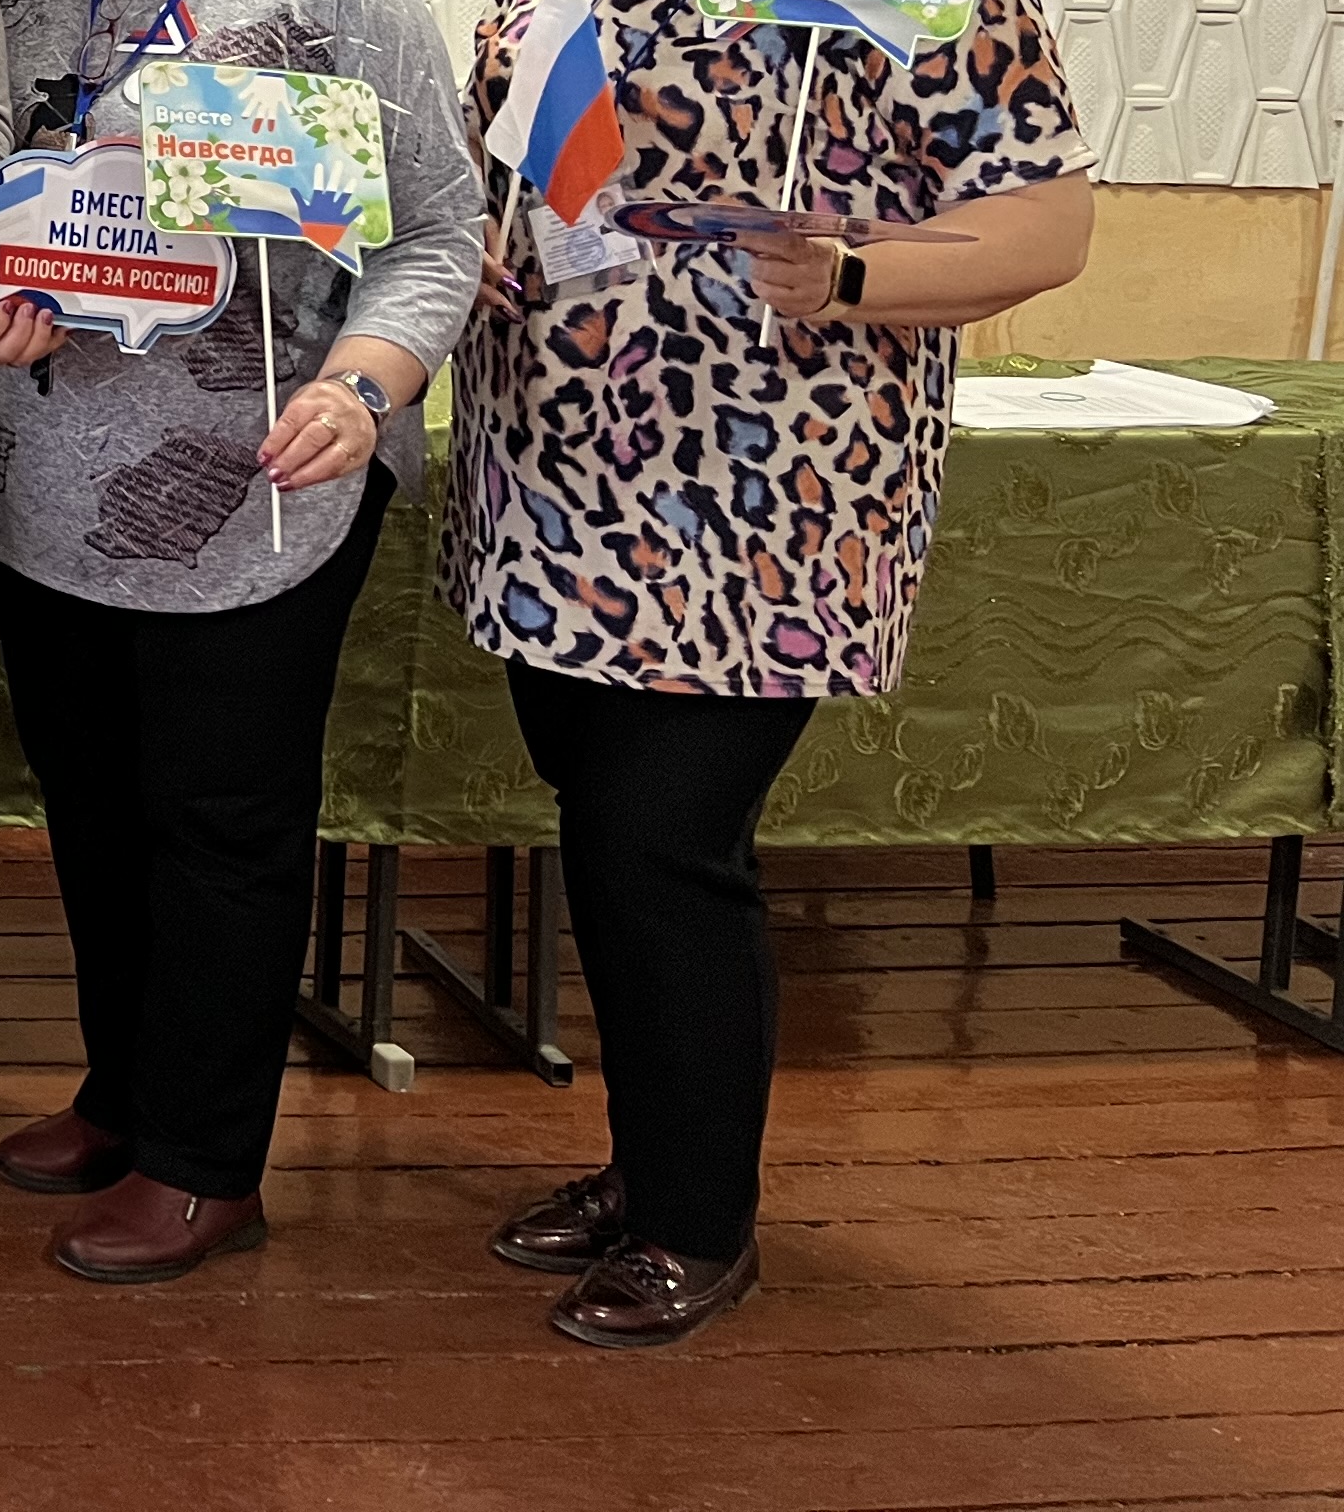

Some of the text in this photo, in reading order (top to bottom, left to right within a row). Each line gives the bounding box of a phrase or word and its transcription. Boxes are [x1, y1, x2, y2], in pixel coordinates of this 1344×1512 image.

[155, 106, 233, 127] Вместе
[157, 134, 294, 167] Навсегда
[70, 189, 145, 220] ВМЕСТ
[49, 220, 89, 248] МЫ
[96, 225, 158, 255] СИЛА
[5, 256, 210, 295] ГОЛОСУЕМ ЗА РОССИЮ!
